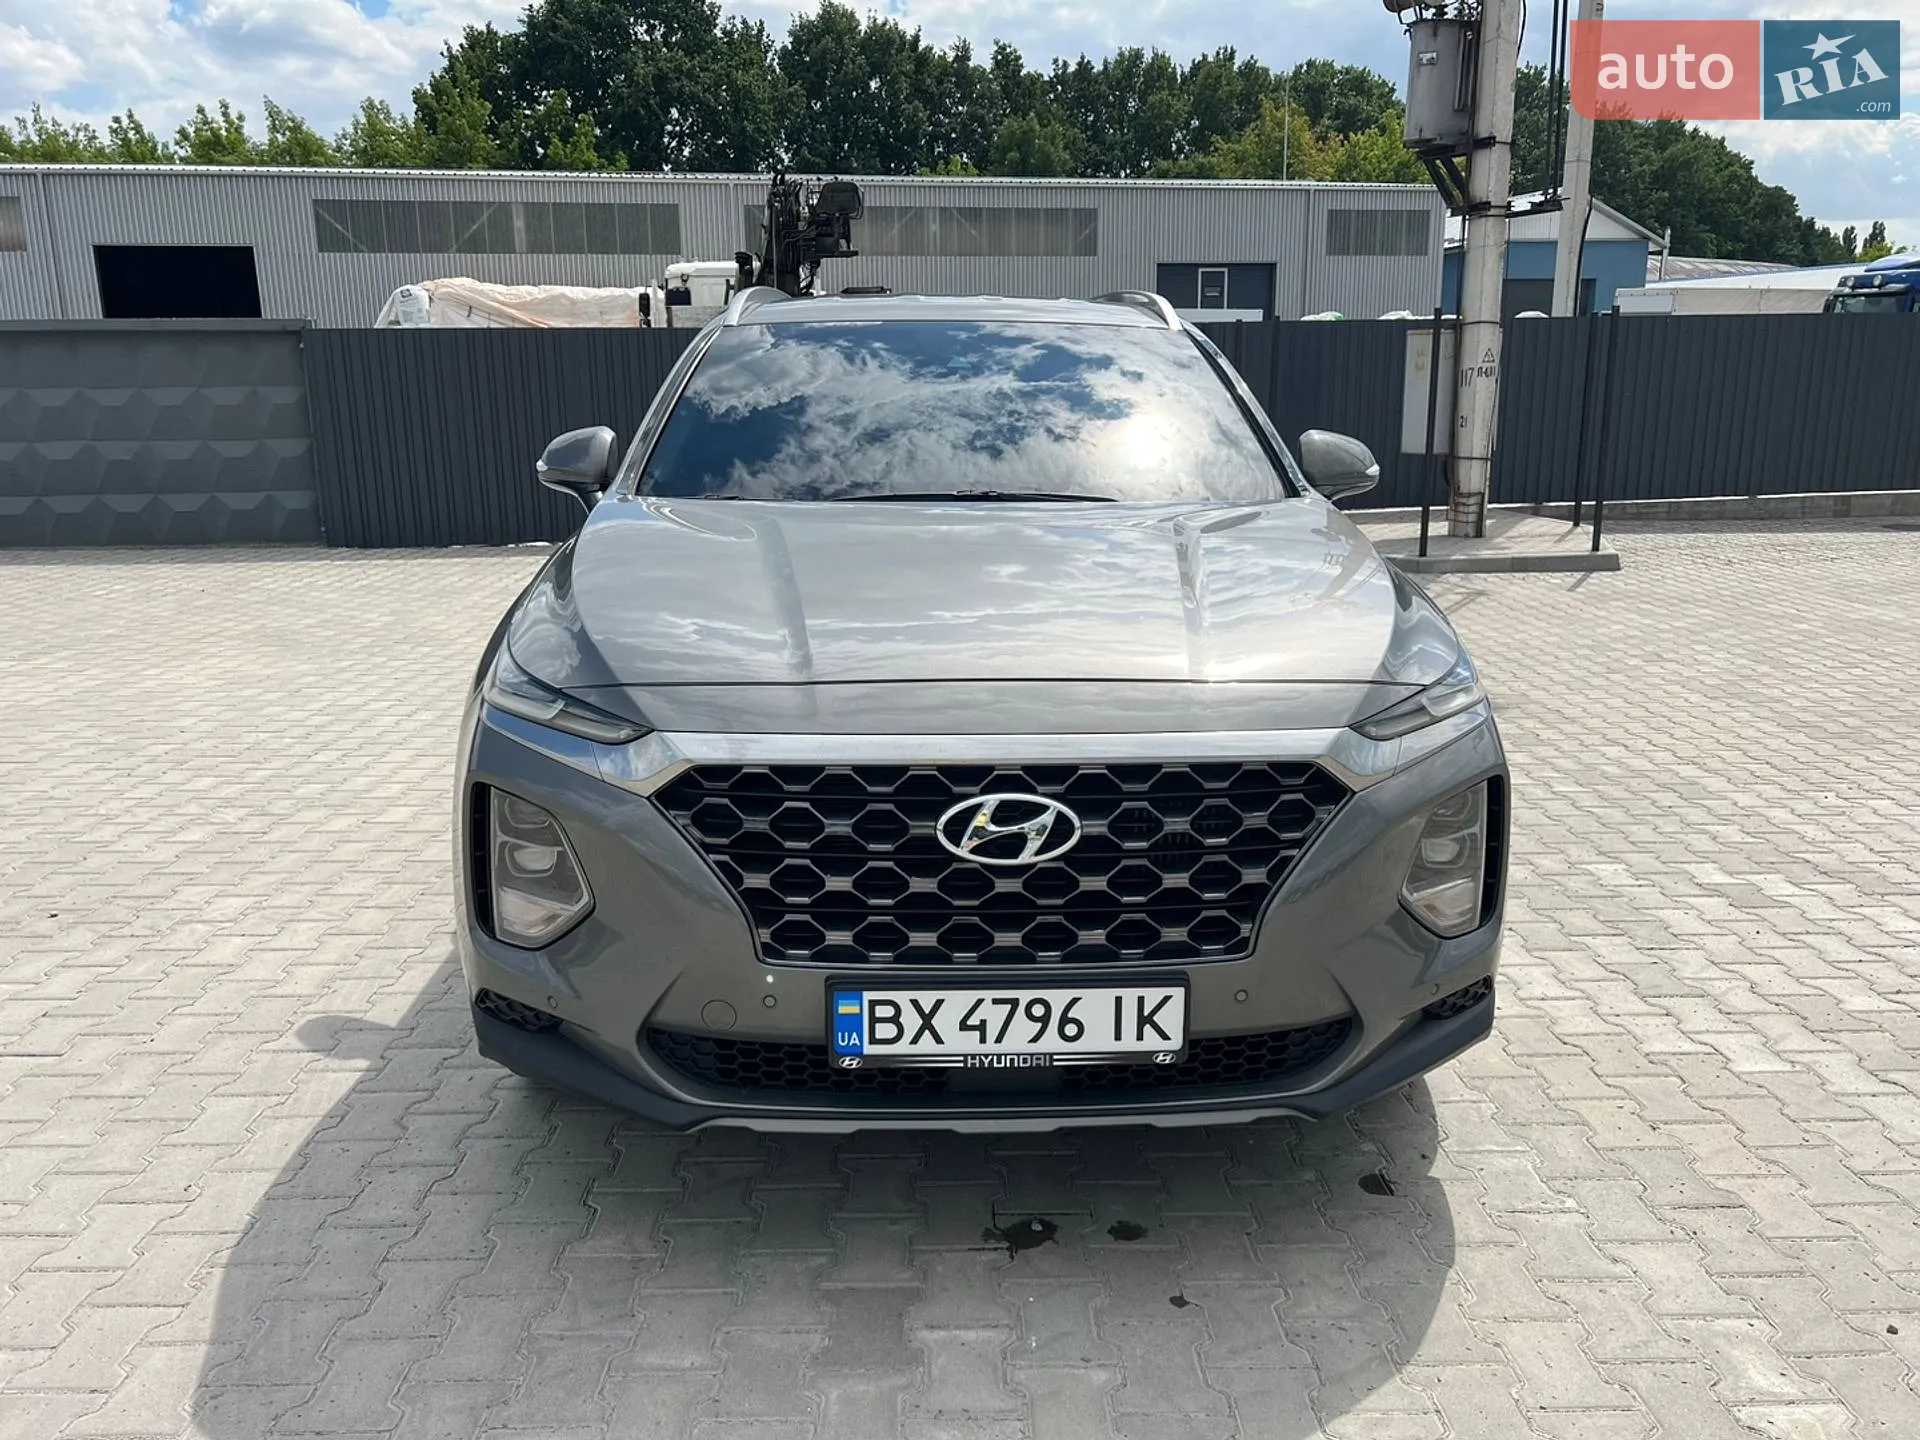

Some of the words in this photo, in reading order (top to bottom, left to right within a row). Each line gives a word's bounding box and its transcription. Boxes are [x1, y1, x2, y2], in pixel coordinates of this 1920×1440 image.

[868, 998, 945, 1045] BX
[959, 997, 1085, 1044] 4796
[1114, 994, 1174, 1042] IK
[838, 1032, 860, 1046] UA
[967, 1054, 1050, 1068] HYUNDAI
